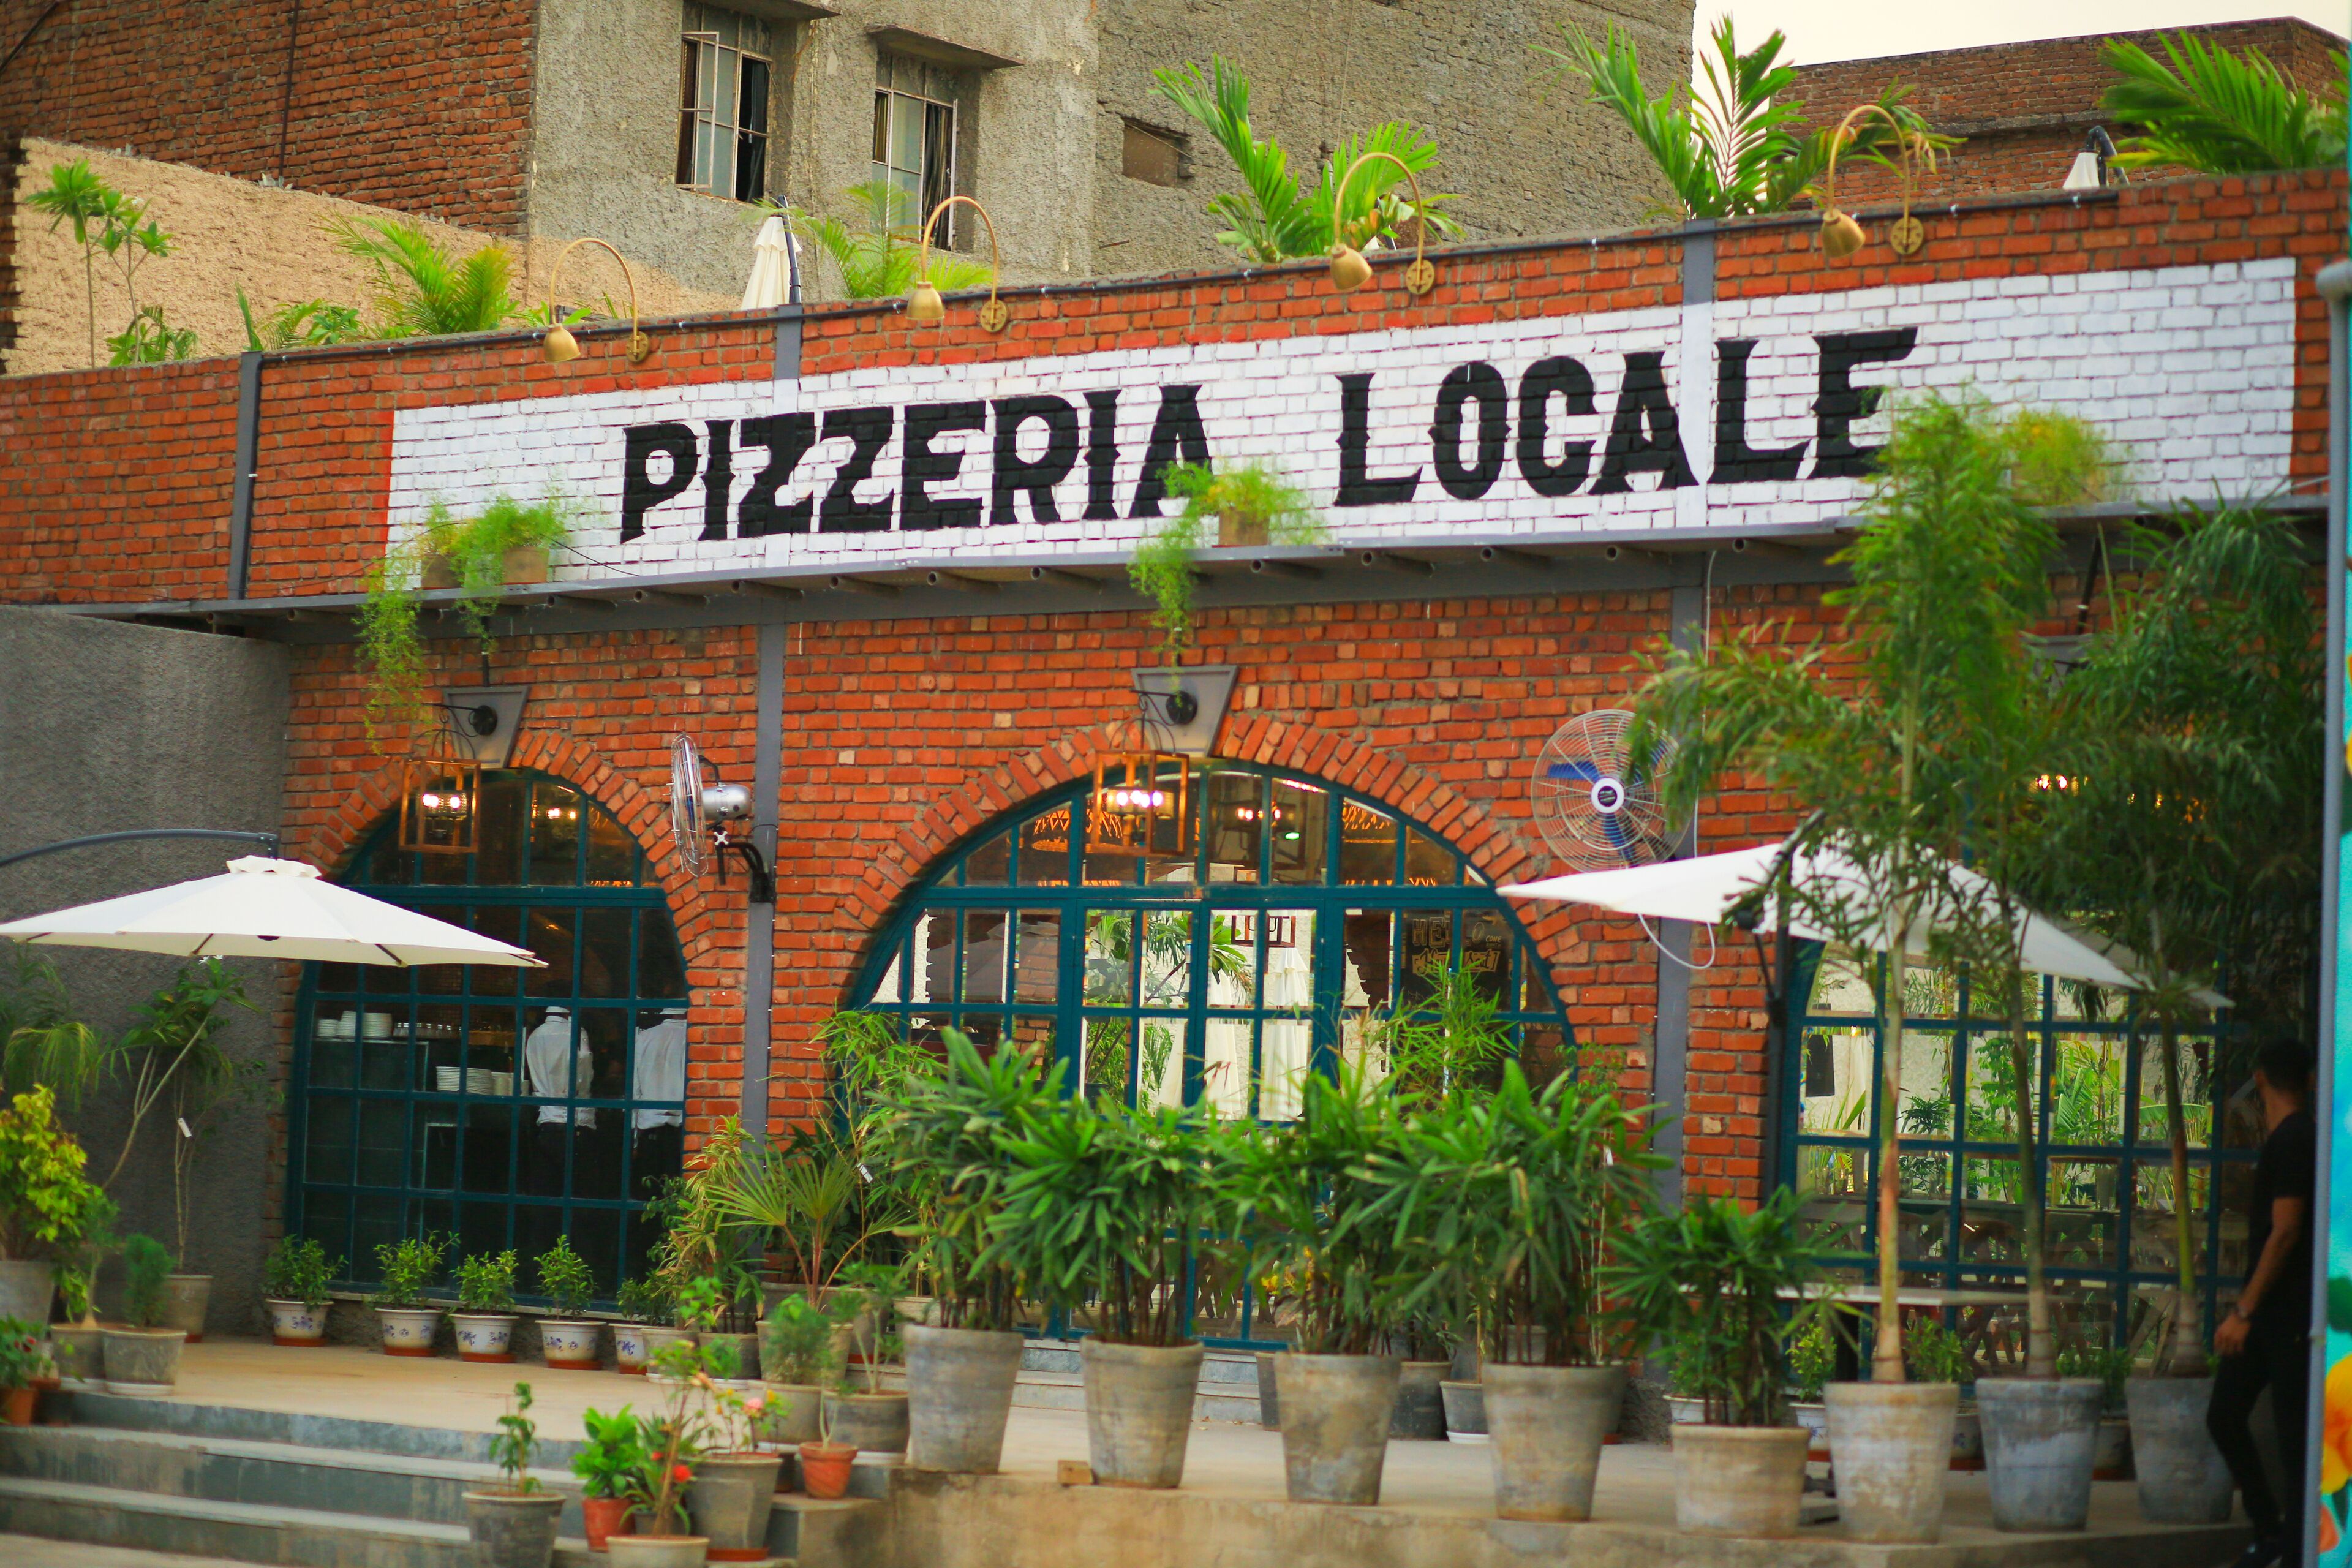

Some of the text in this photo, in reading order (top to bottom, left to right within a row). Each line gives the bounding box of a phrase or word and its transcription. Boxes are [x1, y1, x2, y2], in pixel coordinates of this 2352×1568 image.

[621, 326, 1917, 543] PIZZERIA LOCALE
[1412, 916, 1485, 948] HEO
